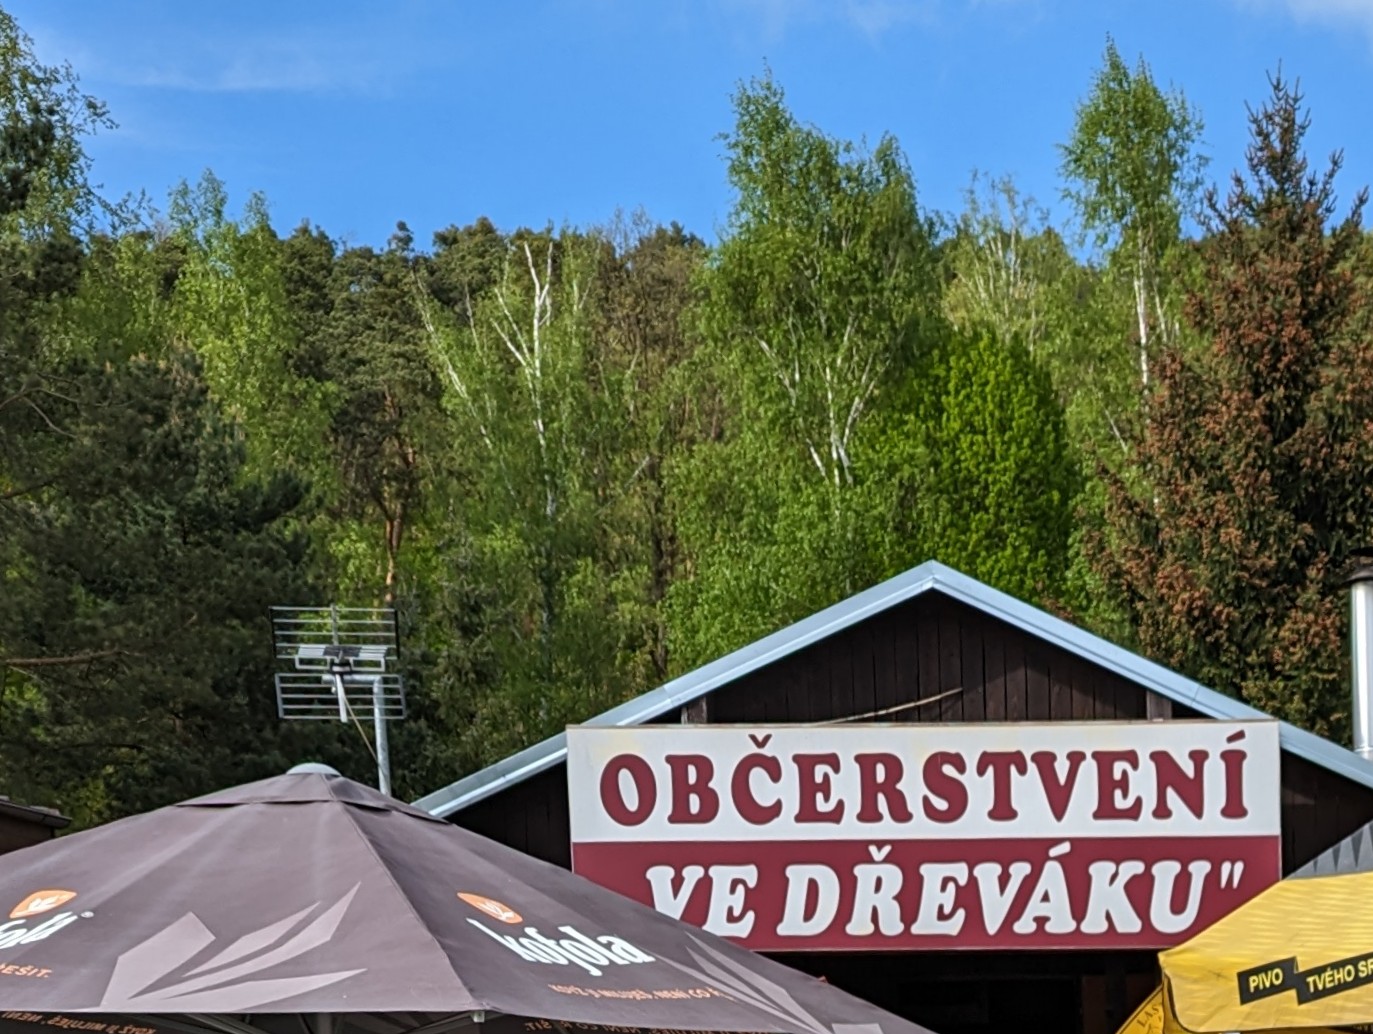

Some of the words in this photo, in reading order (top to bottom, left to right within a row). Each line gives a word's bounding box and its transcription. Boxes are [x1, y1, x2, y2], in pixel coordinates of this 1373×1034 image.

[599, 729, 1249, 826] OBČERSTVENÍ
[644, 862, 759, 938] VE
[465, 917, 656, 977] kofola
[1248, 967, 1284, 993] PIVO
[1306, 965, 1356, 994] TVÉHO
